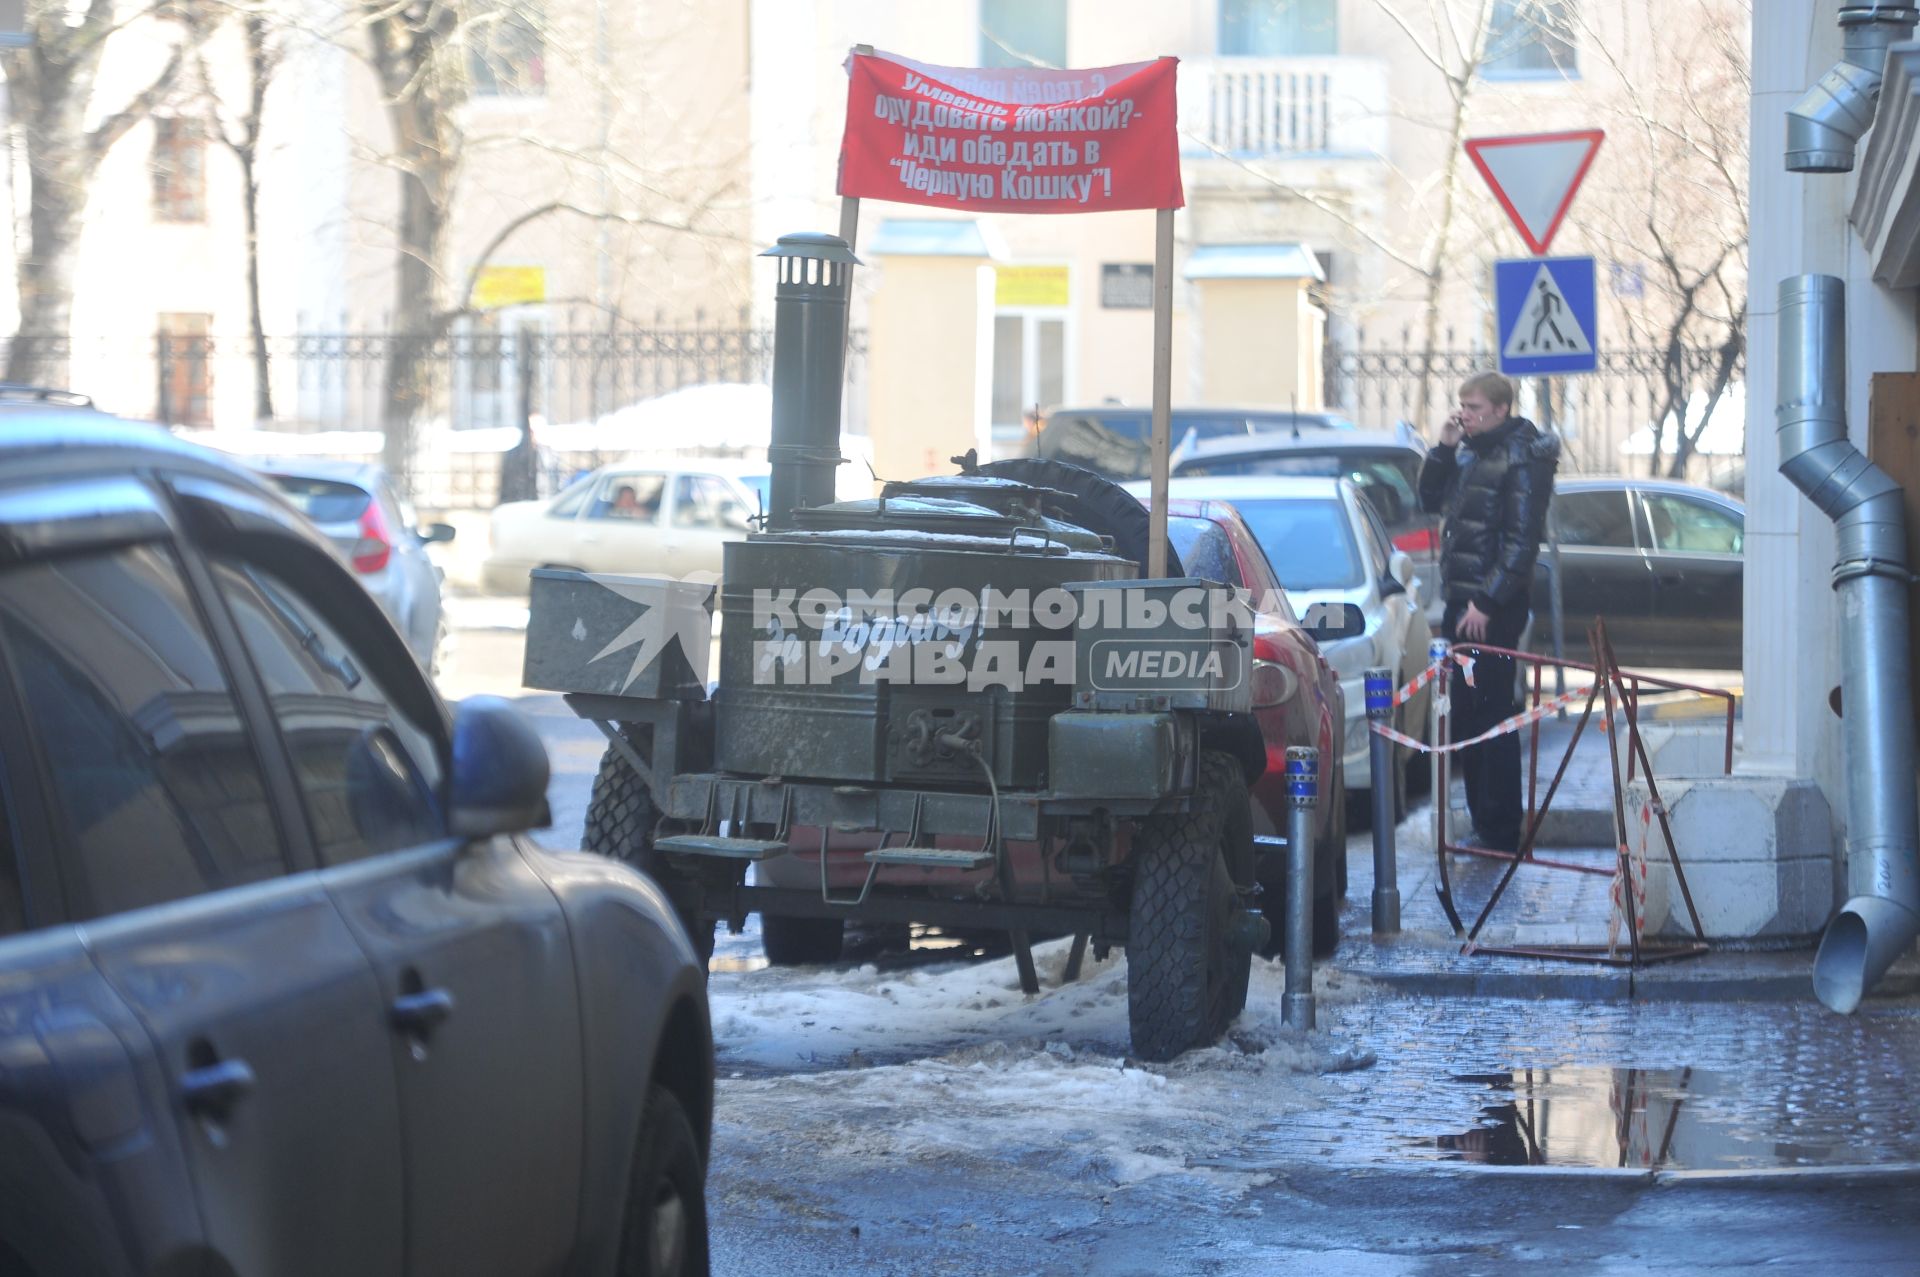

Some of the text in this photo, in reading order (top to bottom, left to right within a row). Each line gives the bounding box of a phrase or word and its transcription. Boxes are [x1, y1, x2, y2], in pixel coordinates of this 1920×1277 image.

[874, 93, 1008, 133] орудовать
[902, 72, 1009, 116] Умеешь
[962, 134, 1078, 171] обедать
[1084, 139, 1100, 165] в
